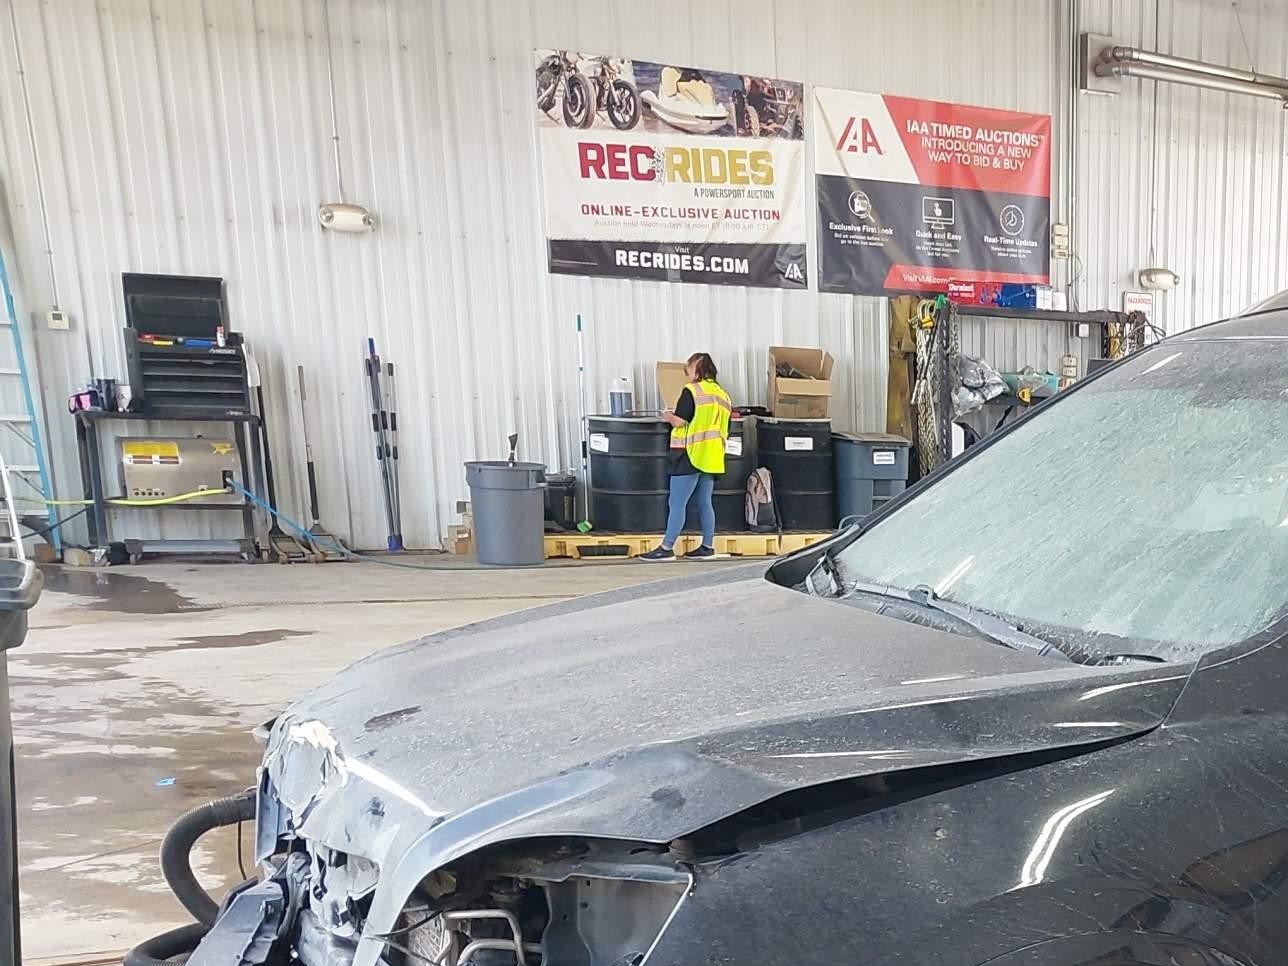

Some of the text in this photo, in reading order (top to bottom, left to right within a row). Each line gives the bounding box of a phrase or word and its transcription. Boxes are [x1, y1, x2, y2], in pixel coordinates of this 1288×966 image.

[907, 120, 929, 135] IAA
[931, 122, 972, 140] TIMED
[921, 138, 1032, 159] INTRODUCING A NEW
[577, 142, 775, 186] REC RIDES
[928, 150, 1025, 171] WAY TO BID & BUY
[694, 187, 775, 200] A POWERSPORT AUCTION
[581, 203, 780, 221] ONLINE-EXCLUSIVE AUCTION
[829, 221, 861, 232] Exclusive
[915, 229, 962, 242] Quick and Easy
[675, 245, 690, 255] Visit
[615, 249, 749, 275] RECRIDES.COM
